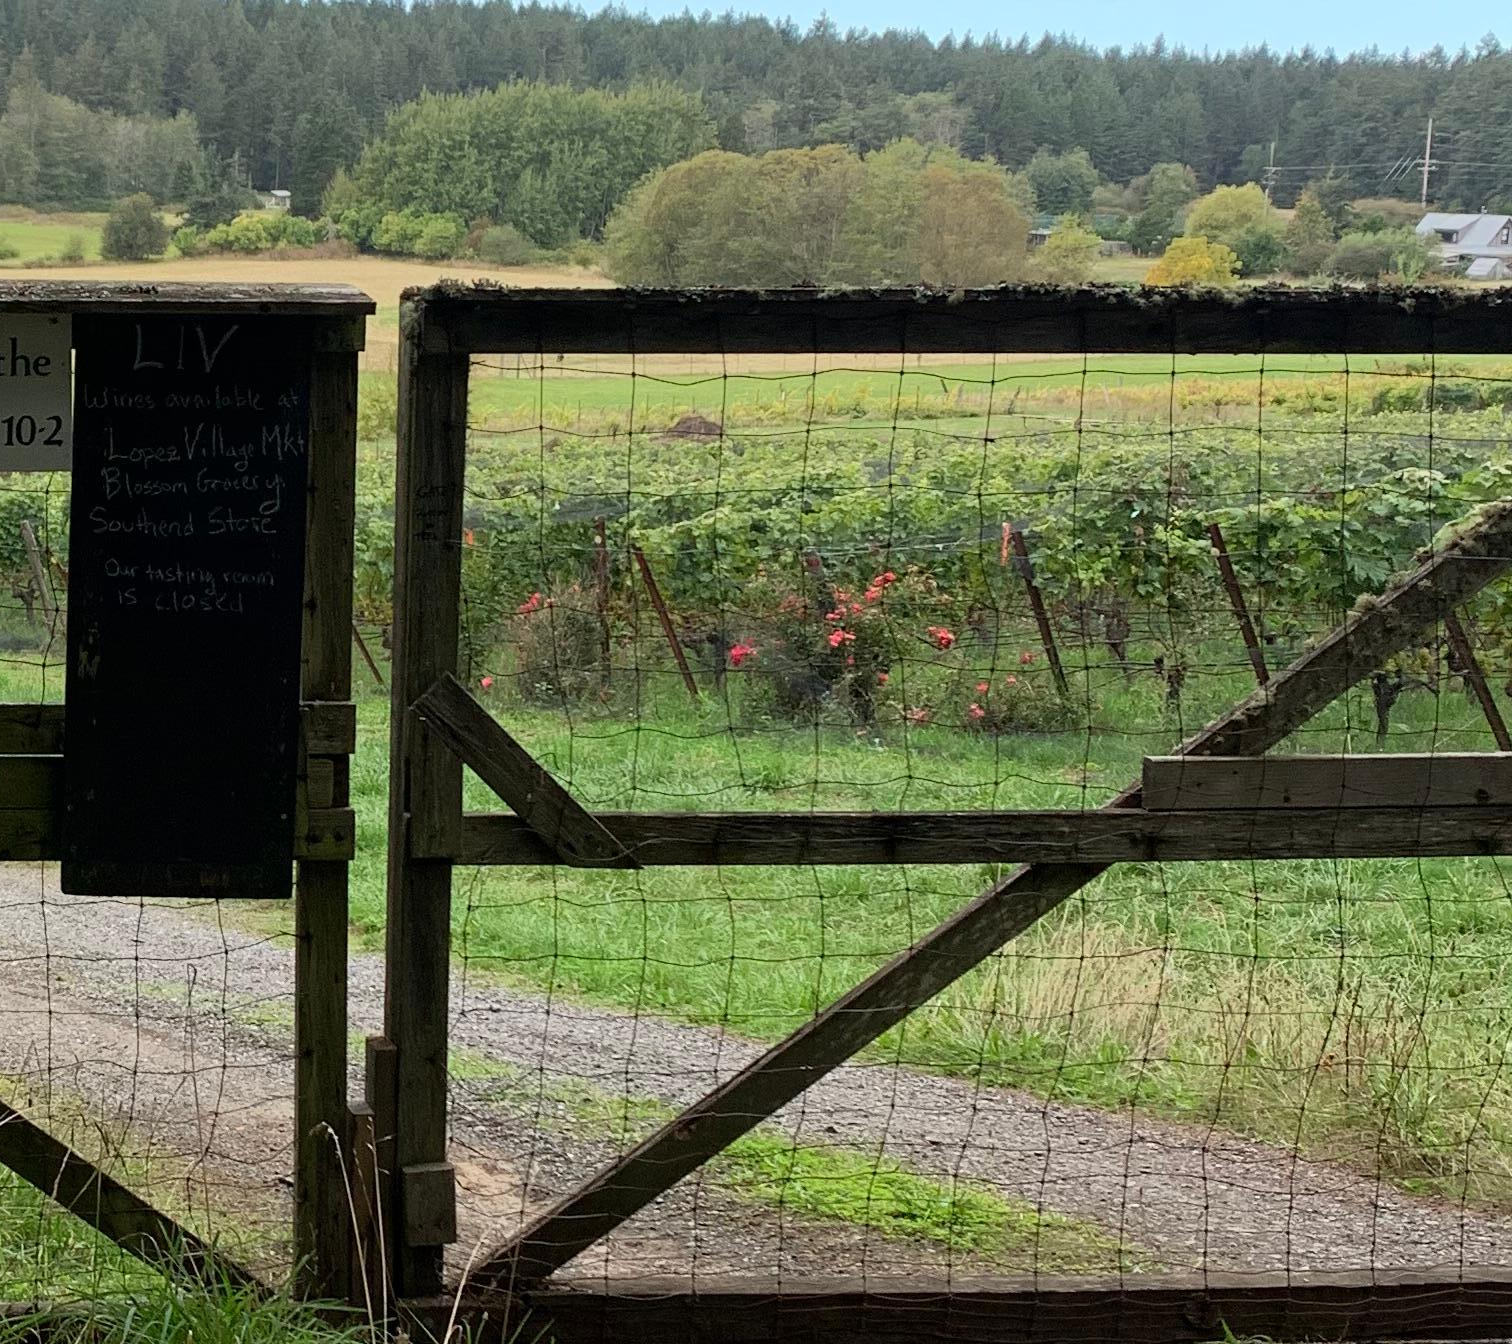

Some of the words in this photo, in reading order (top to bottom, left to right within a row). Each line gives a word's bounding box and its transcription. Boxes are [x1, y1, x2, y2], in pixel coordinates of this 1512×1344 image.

[84, 384, 156, 409] Wines
[165, 385, 265, 410] available
[277, 389, 300, 407] at
[1, 414, 64, 447] 10-2
[107, 426, 181, 469] Lopez
[184, 422, 254, 471] Village
[261, 422, 305, 460] Mkt
[100, 467, 188, 499] Blossom
[88, 506, 194, 537] Southend
[207, 506, 278, 535] Store
[104, 558, 138, 577] Our
[145, 562, 216, 596] tasting
[222, 567, 275, 586] room
[155, 590, 244, 613] closed
